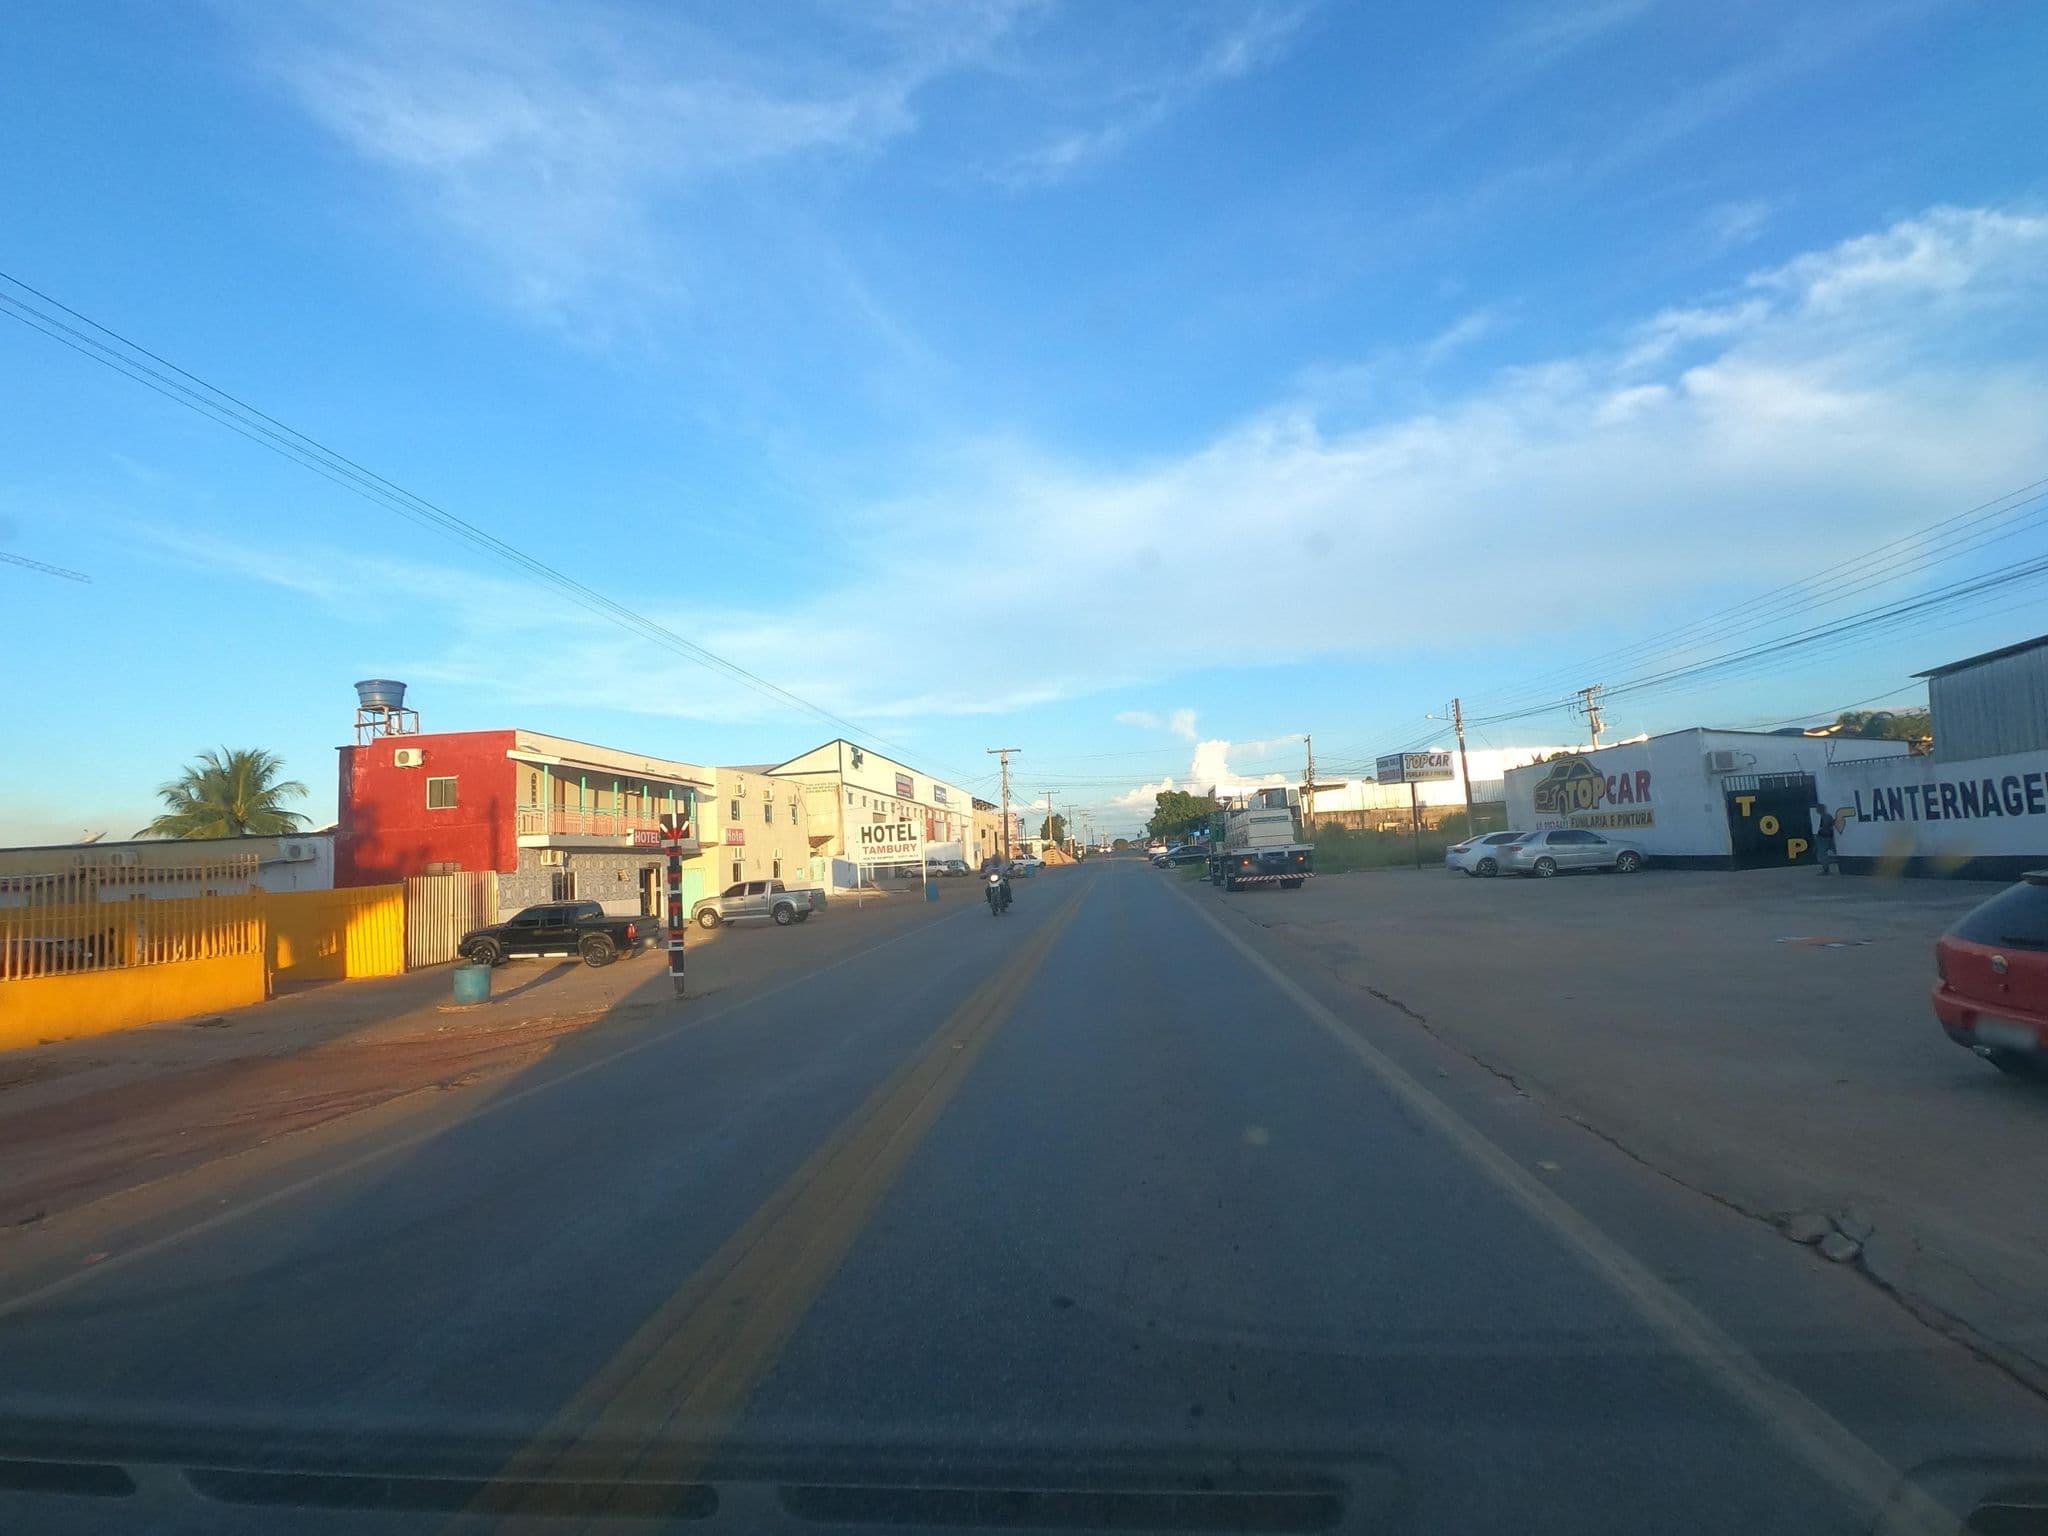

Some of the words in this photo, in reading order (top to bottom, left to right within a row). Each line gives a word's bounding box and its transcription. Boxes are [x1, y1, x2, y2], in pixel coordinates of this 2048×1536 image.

[1855, 771, 2048, 823] LANTERNAGE
[1611, 814, 1617, 826] E
[634, 831, 660, 844] HOTEL
[727, 829, 744, 842] Hotel
[861, 823, 917, 843] HOTEL
[862, 843, 917, 854] TAMBURY
